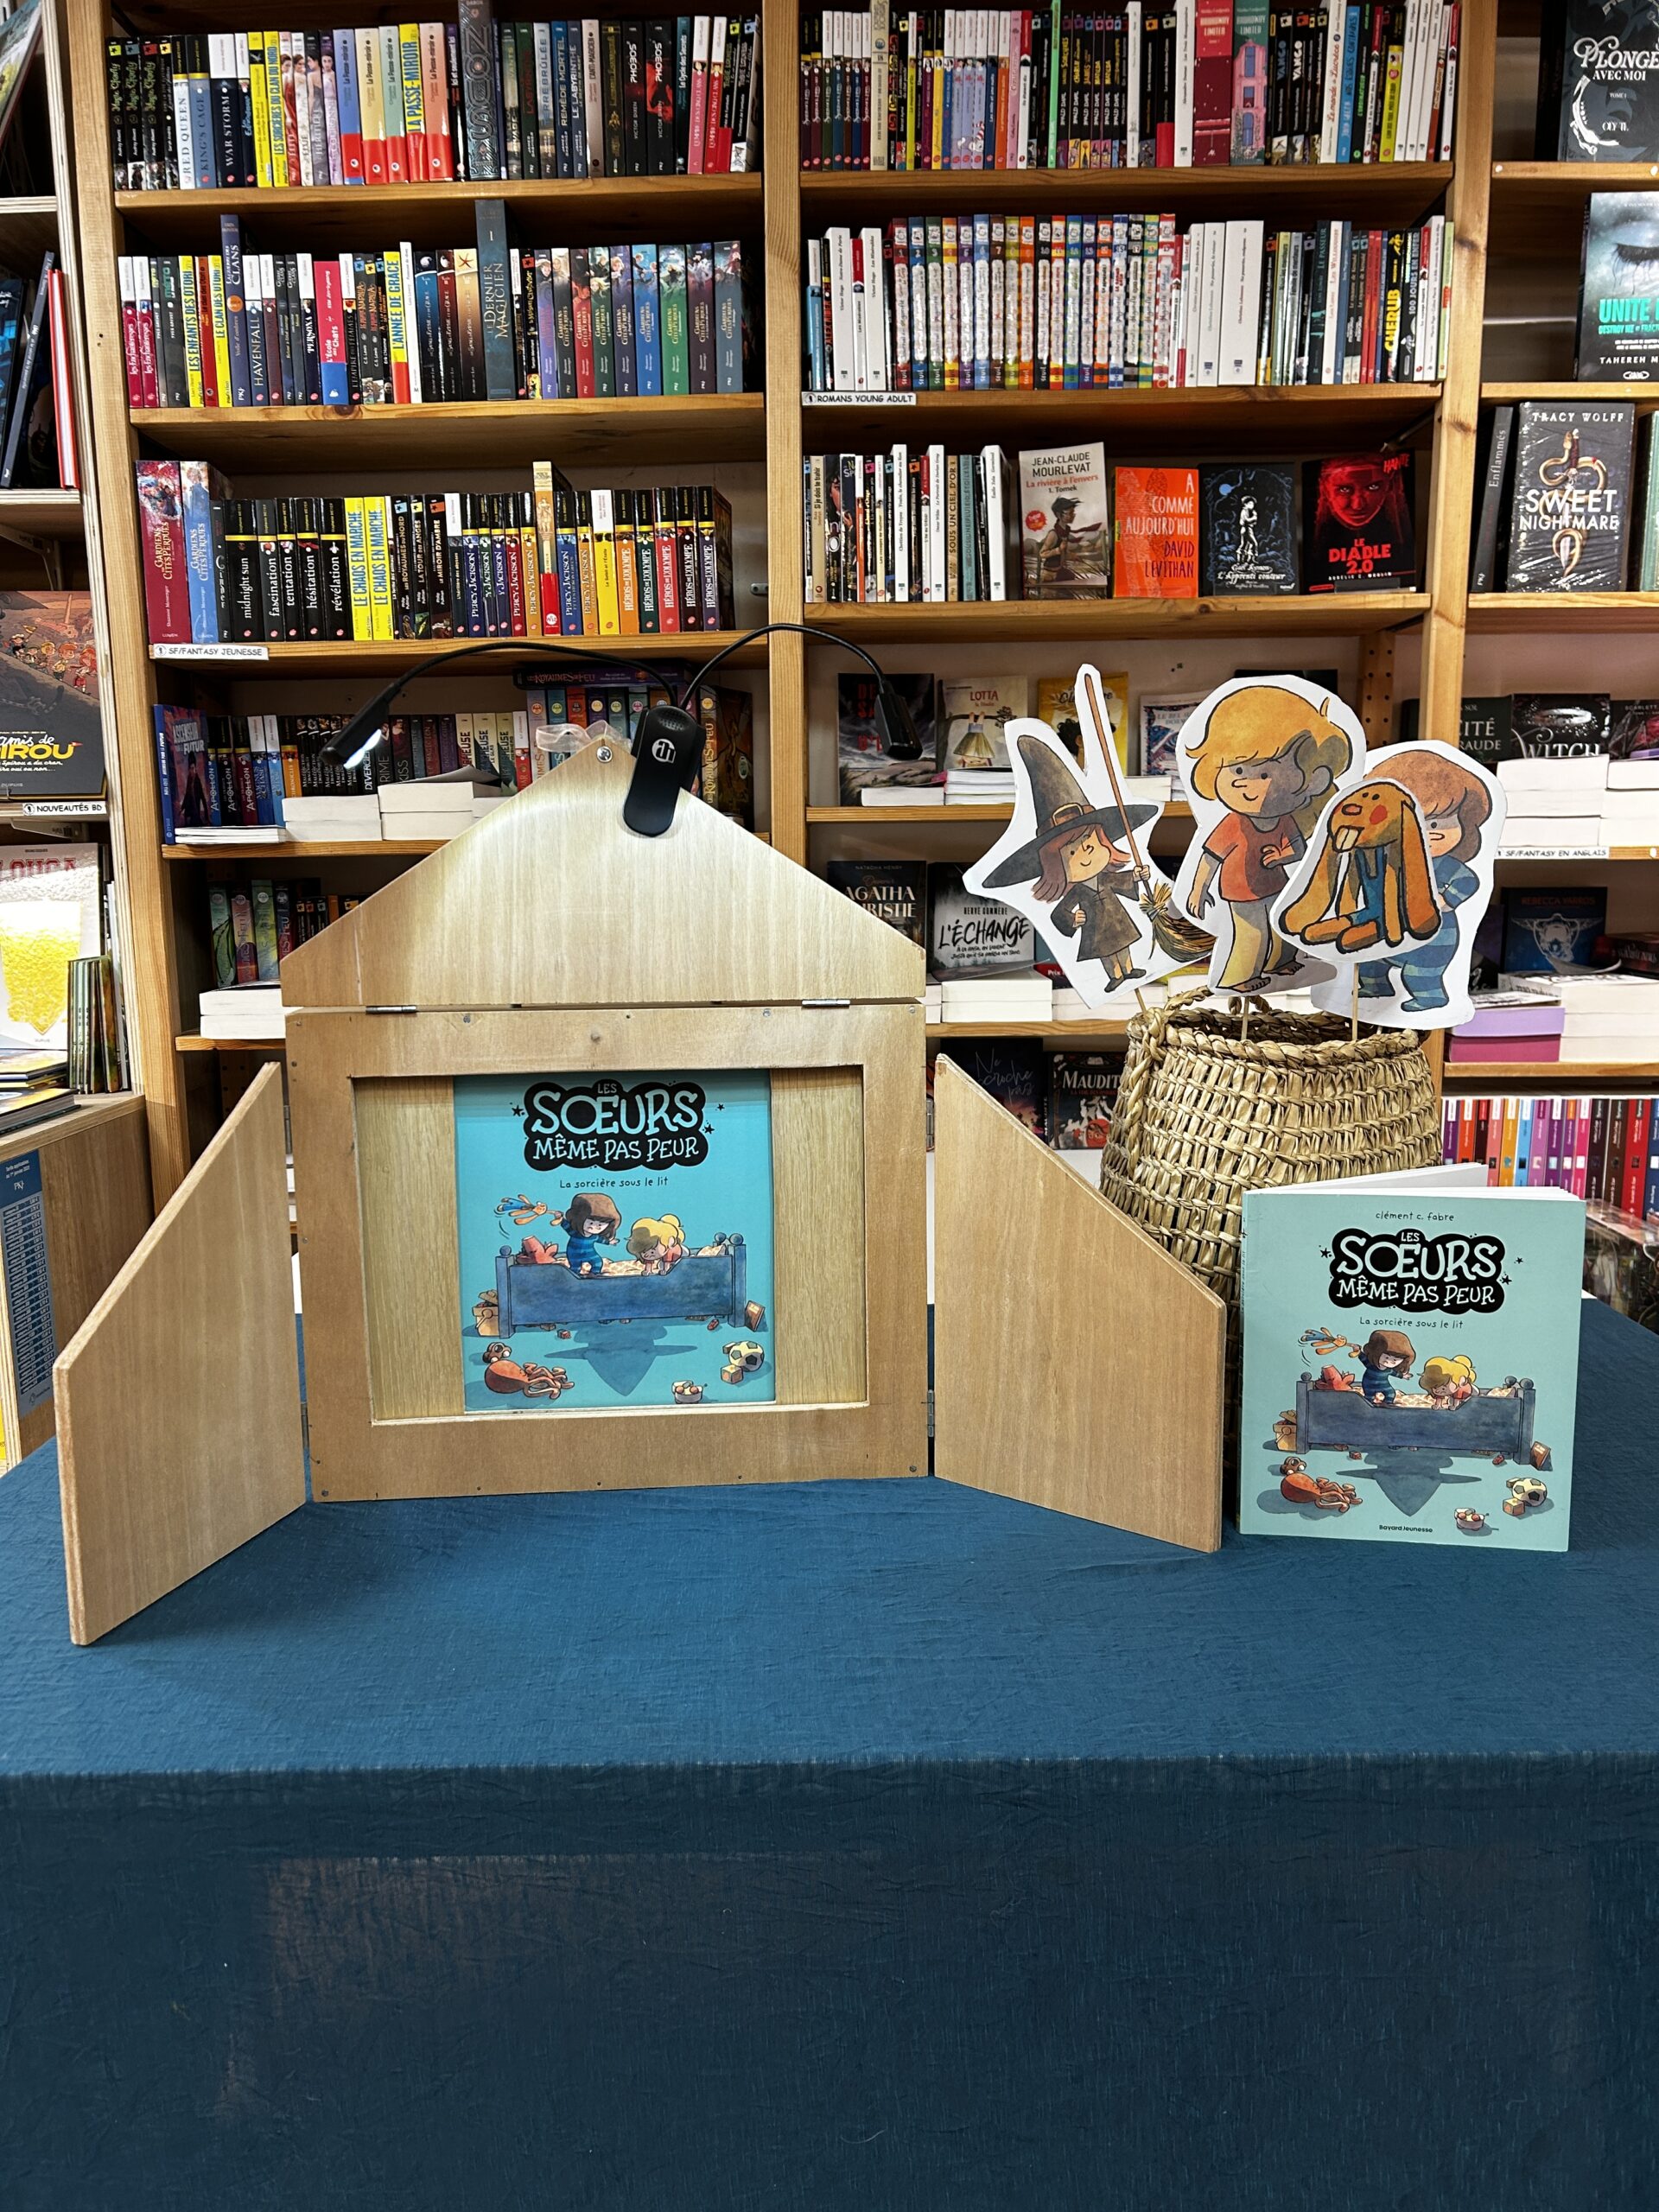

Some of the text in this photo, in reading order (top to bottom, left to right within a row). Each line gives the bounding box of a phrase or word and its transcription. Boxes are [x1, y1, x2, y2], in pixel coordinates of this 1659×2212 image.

[1204, 27, 1225, 36] LIMITED
[1240, 26, 1262, 35] LIMITED
[1573, 35, 1659, 69] PLONGE
[402, 41, 422, 132] LA PASSE-MIROIR
[557, 37, 568, 126] REMÈDE MORTEL
[569, 45, 579, 118] LE LABYRINTHE
[679, 67, 688, 81] Cycle
[1592, 70, 1646, 81] AVEC MOI
[178, 98, 191, 173] RED QUEEN
[196, 96, 208, 170] KING'S CAGE
[221, 97, 234, 166] WAR STORM
[230, 245, 241, 285] CLANS
[1411, 257, 1419, 270] EN
[1409, 271, 1418, 298] JOURS
[213, 294, 223, 308] DES
[385, 260, 404, 349] L'ANNÉE DE GRÂCE
[493, 263, 509, 338] MAGICIEN
[1599, 298, 1650, 323] UNITE
[182, 271, 200, 372] LES ENFANTS DES OTORI
[214, 310, 224, 327] CLAN
[1384, 289, 1401, 352] CHERUB
[215, 329, 226, 338] LE
[250, 317, 264, 385] HAVENFALL
[1532, 412, 1624, 422] TRACY WOLFF
[1033, 452, 1090, 467] JEAN-CLAUDE
[1033, 462, 1091, 478] MOURLEVAT
[1488, 429, 1505, 487] Enflammés
[1037, 477, 1062, 487] rivière
[1070, 474, 1098, 484] l'envers
[1186, 473, 1194, 493] A
[1152, 496, 1194, 514] COMME
[1525, 489, 1618, 513] SWEET
[950, 514, 956, 526] UN
[1125, 517, 1194, 536] AUJOURD'HUI
[1519, 515, 1620, 531] NIGHTMARE
[154, 527, 164, 568] GARDIENS
[189, 529, 199, 569] GARDIENS
[1164, 541, 1194, 558] DAVID
[1329, 543, 1391, 563] DIABLE
[1354, 538, 1365, 547] LE
[347, 512, 368, 607] LE CHAOS EN MARCHE
[368, 510, 389, 605] LE CHAOS EN MARCHE
[1145, 561, 1194, 578] LEVITHAN
[1346, 560, 1374, 574] 2.0
[283, 556, 295, 606] tentation
[306, 555, 317, 608] hésitation
[511, 551, 521, 590] JACKSON
[561, 550, 573, 615] PERCY JACKSON
[237, 557, 254, 619] midnight sun
[266, 558, 280, 616] fascination
[329, 556, 342, 611] révélation
[467, 552, 479, 617] PERCY JACKSON
[970, 690, 999, 701] LOTTA
[183, 740, 205, 754] FUTUR
[36, 804, 89, 812] NOUVEAUTÉS
[845, 886, 916, 901] AGATHA
[938, 915, 1031, 950] L'ÉCHANGE
[598, 1083, 617, 1094] LES
[531, 1089, 698, 1136] SŒURS
[533, 1134, 699, 1164] MÊME PAS PEUR
[560, 1176, 669, 1189] La sorcière sous le lit
[1375, 1211, 1414, 1220] clément
[1427, 1212, 1454, 1222] fabre
[1401, 1232, 1420, 1243] LES
[1337, 1235, 1498, 1282] SŒURS
[1336, 1275, 1495, 1307] MÊME PAS PEUR
[1360, 1317, 1370, 1325] La
[1374, 1317, 1413, 1327] sorcière
[1440, 1319, 1449, 1328] le
[1452, 1320, 1464, 1329] lit
